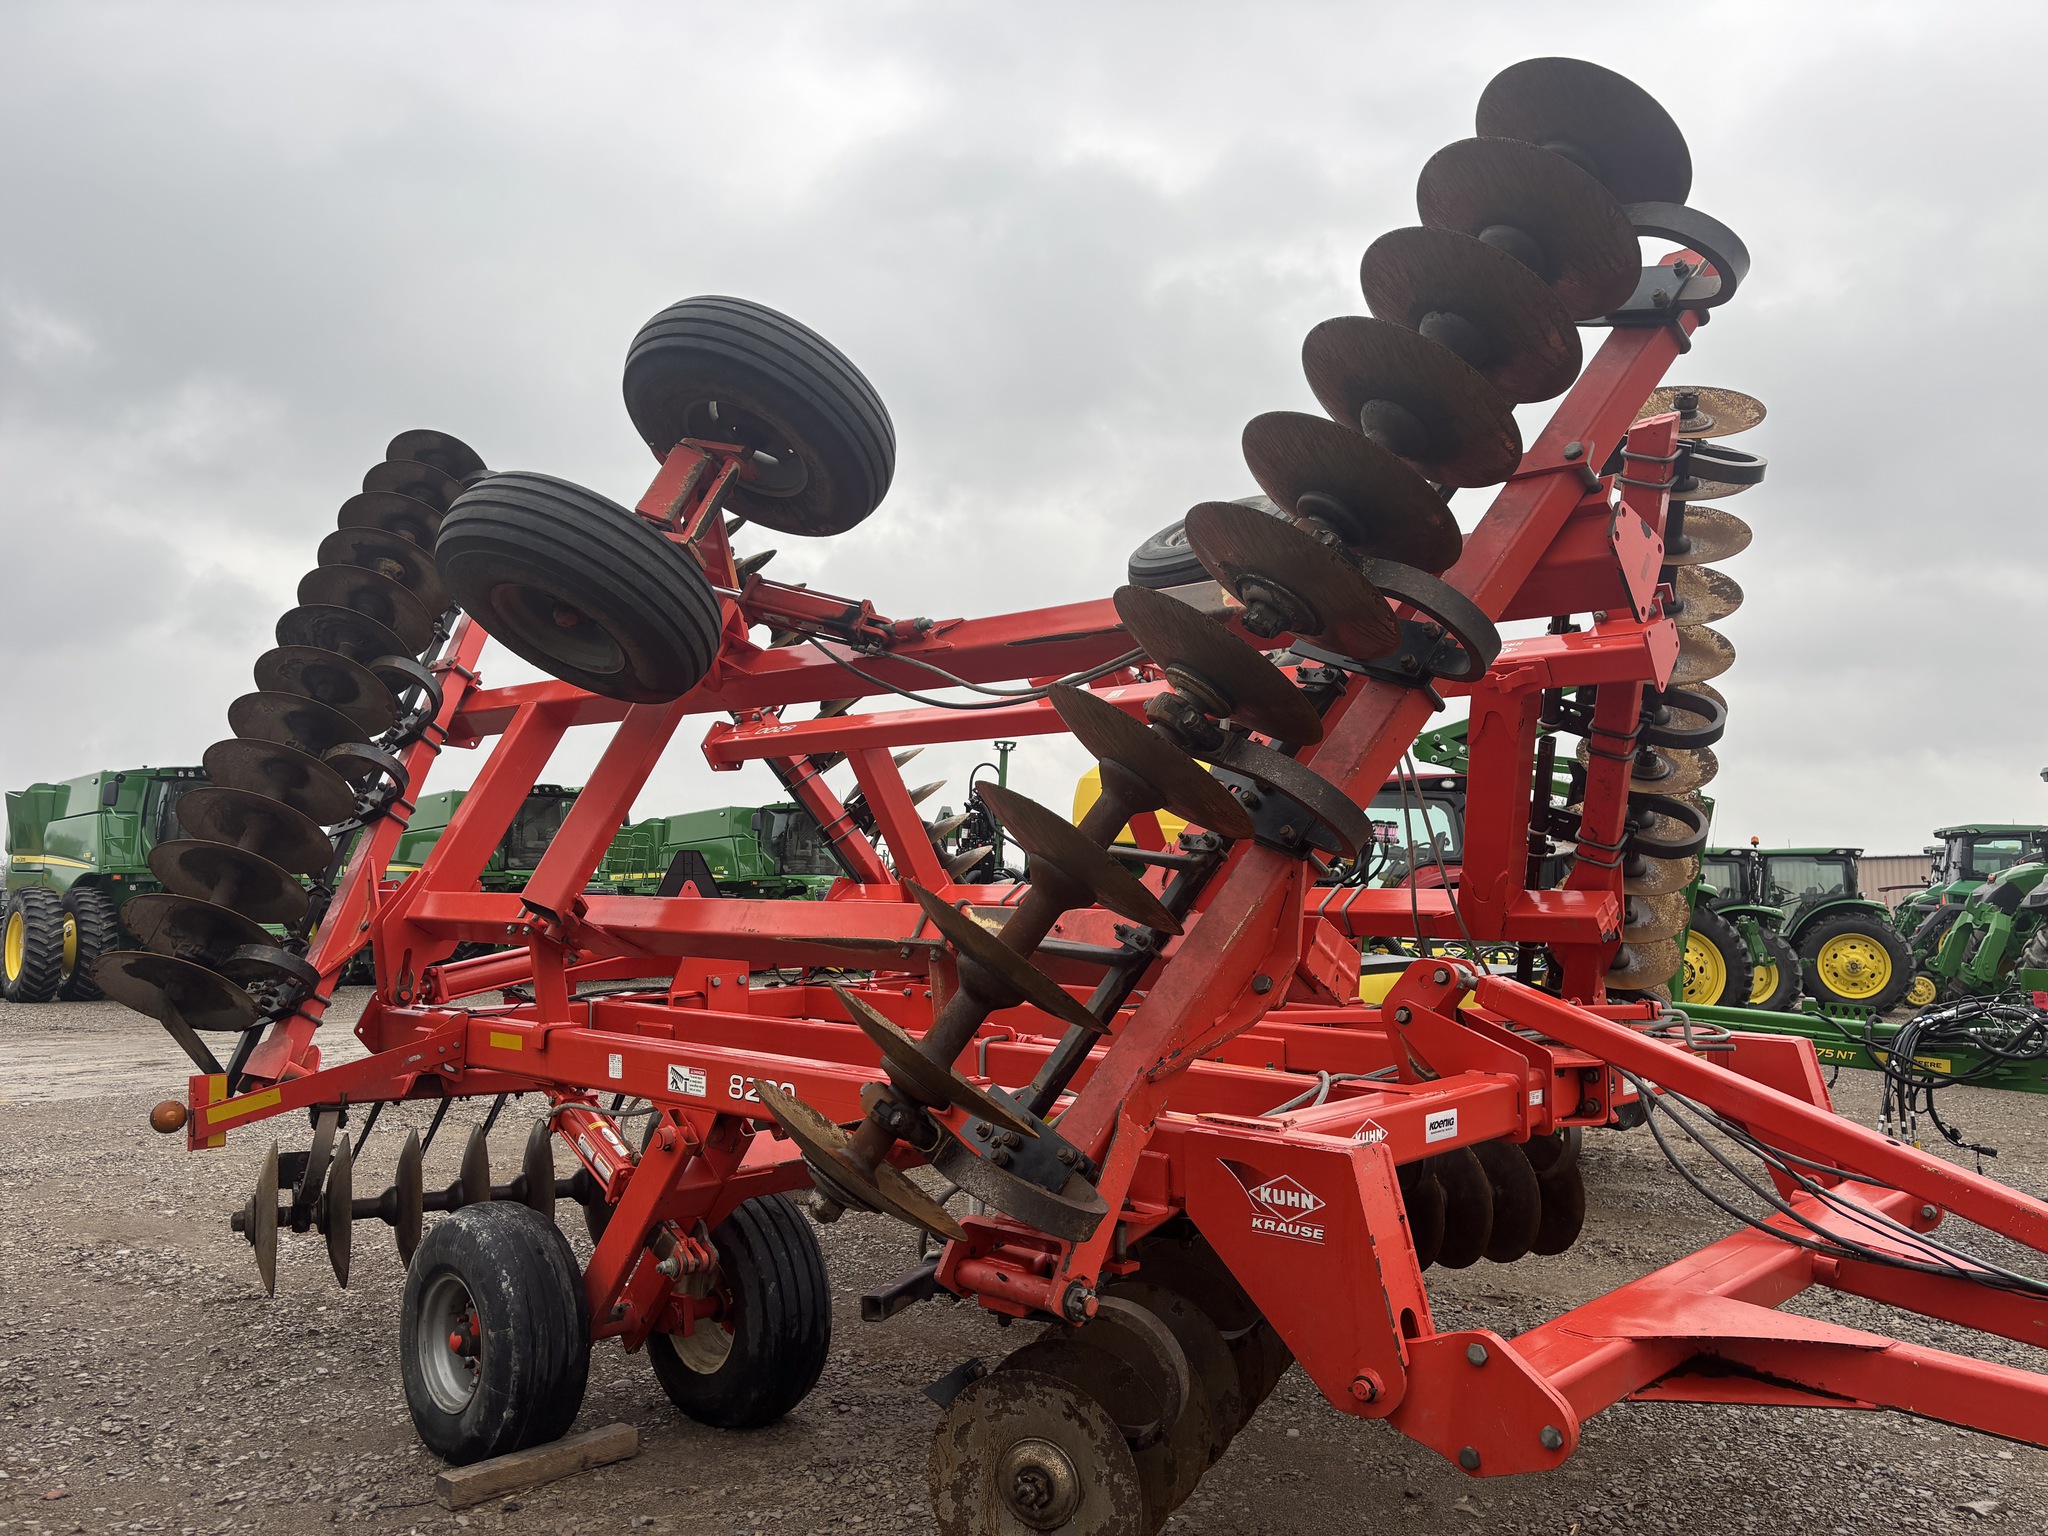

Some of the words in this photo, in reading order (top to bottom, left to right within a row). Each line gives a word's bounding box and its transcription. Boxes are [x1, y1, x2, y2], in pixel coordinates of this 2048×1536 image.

[1814, 1047, 1834, 1058] 75
[1836, 1050, 1857, 1060] NT
[1260, 1186, 1314, 1210] KUHN
[1251, 1218, 1325, 1240] KRAUSE
